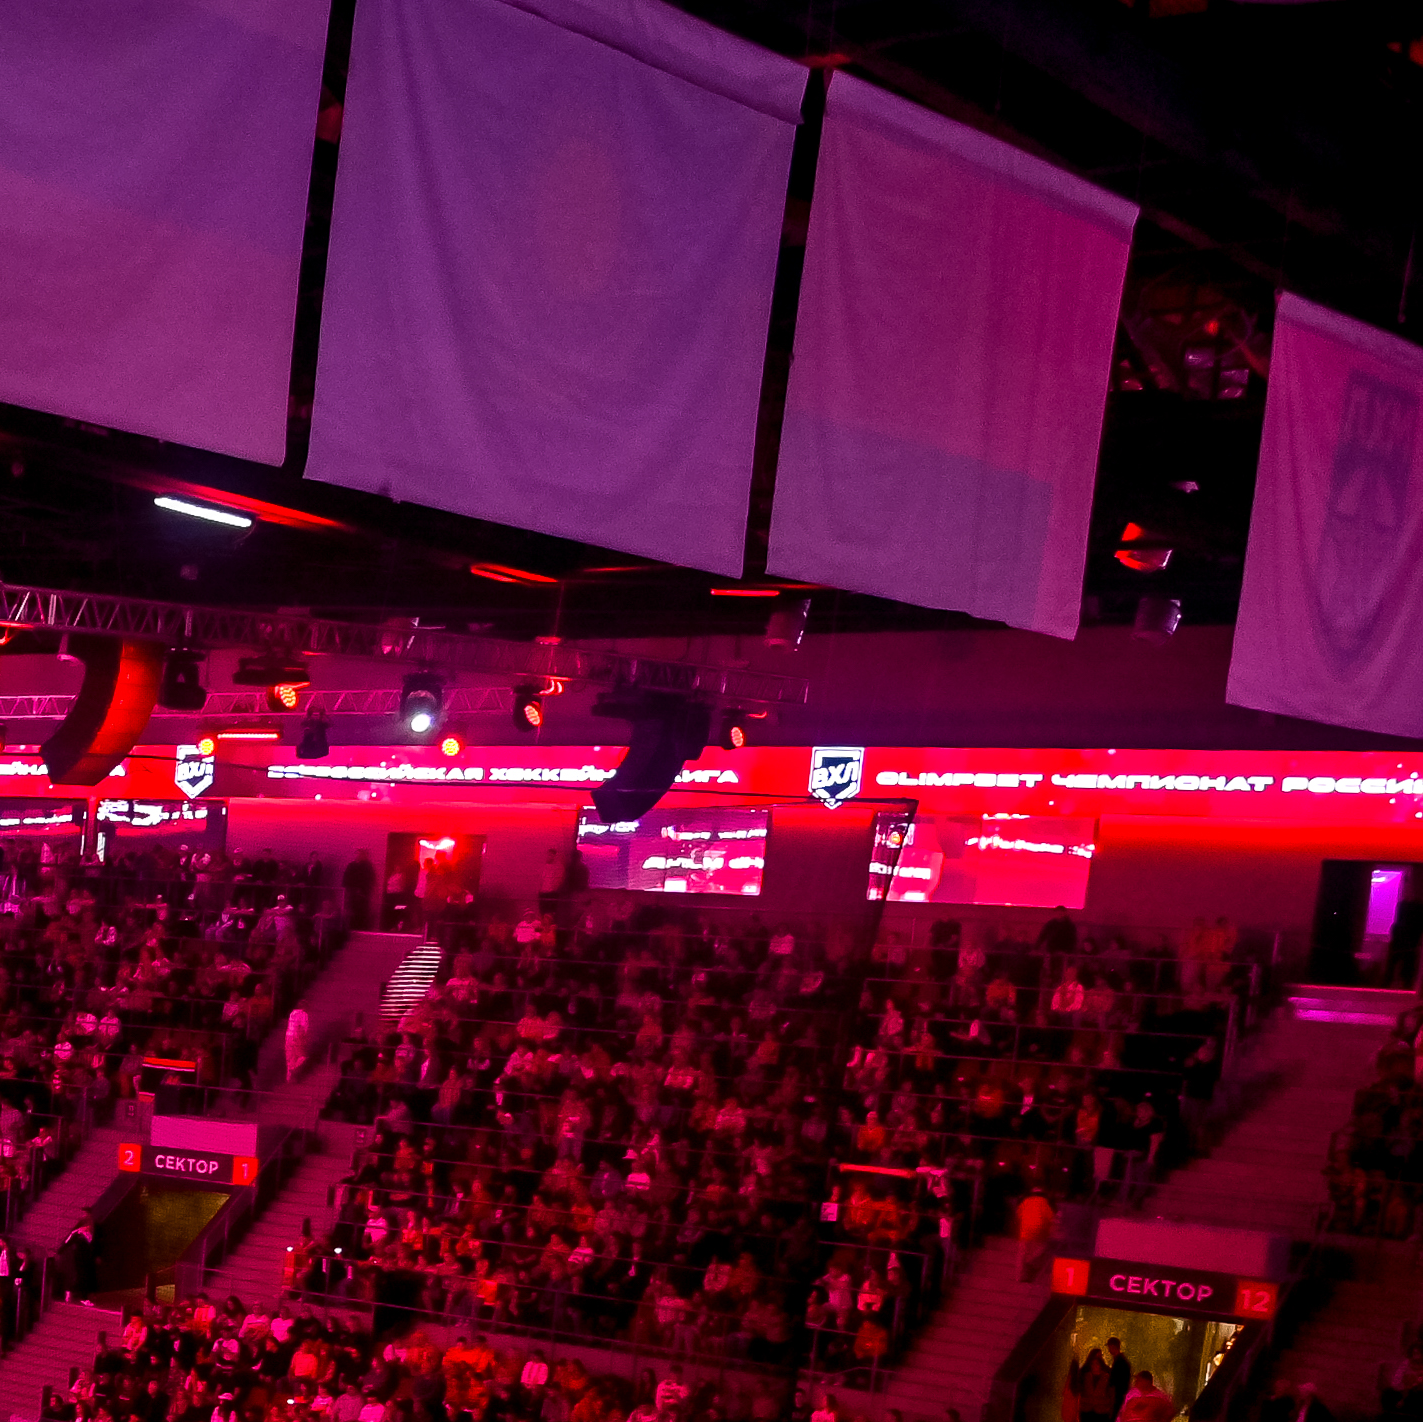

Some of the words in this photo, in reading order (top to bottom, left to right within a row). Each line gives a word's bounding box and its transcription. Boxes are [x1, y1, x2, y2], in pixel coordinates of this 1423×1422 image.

[811, 761, 861, 786] ВХЛ
[124, 1150, 134, 1166] 2
[155, 1154, 219, 1175] СЕКТОР
[1066, 1267, 1075, 1287] 1
[1109, 1273, 1214, 1302] СЕКТОР
[1240, 1288, 1271, 1313] 12
